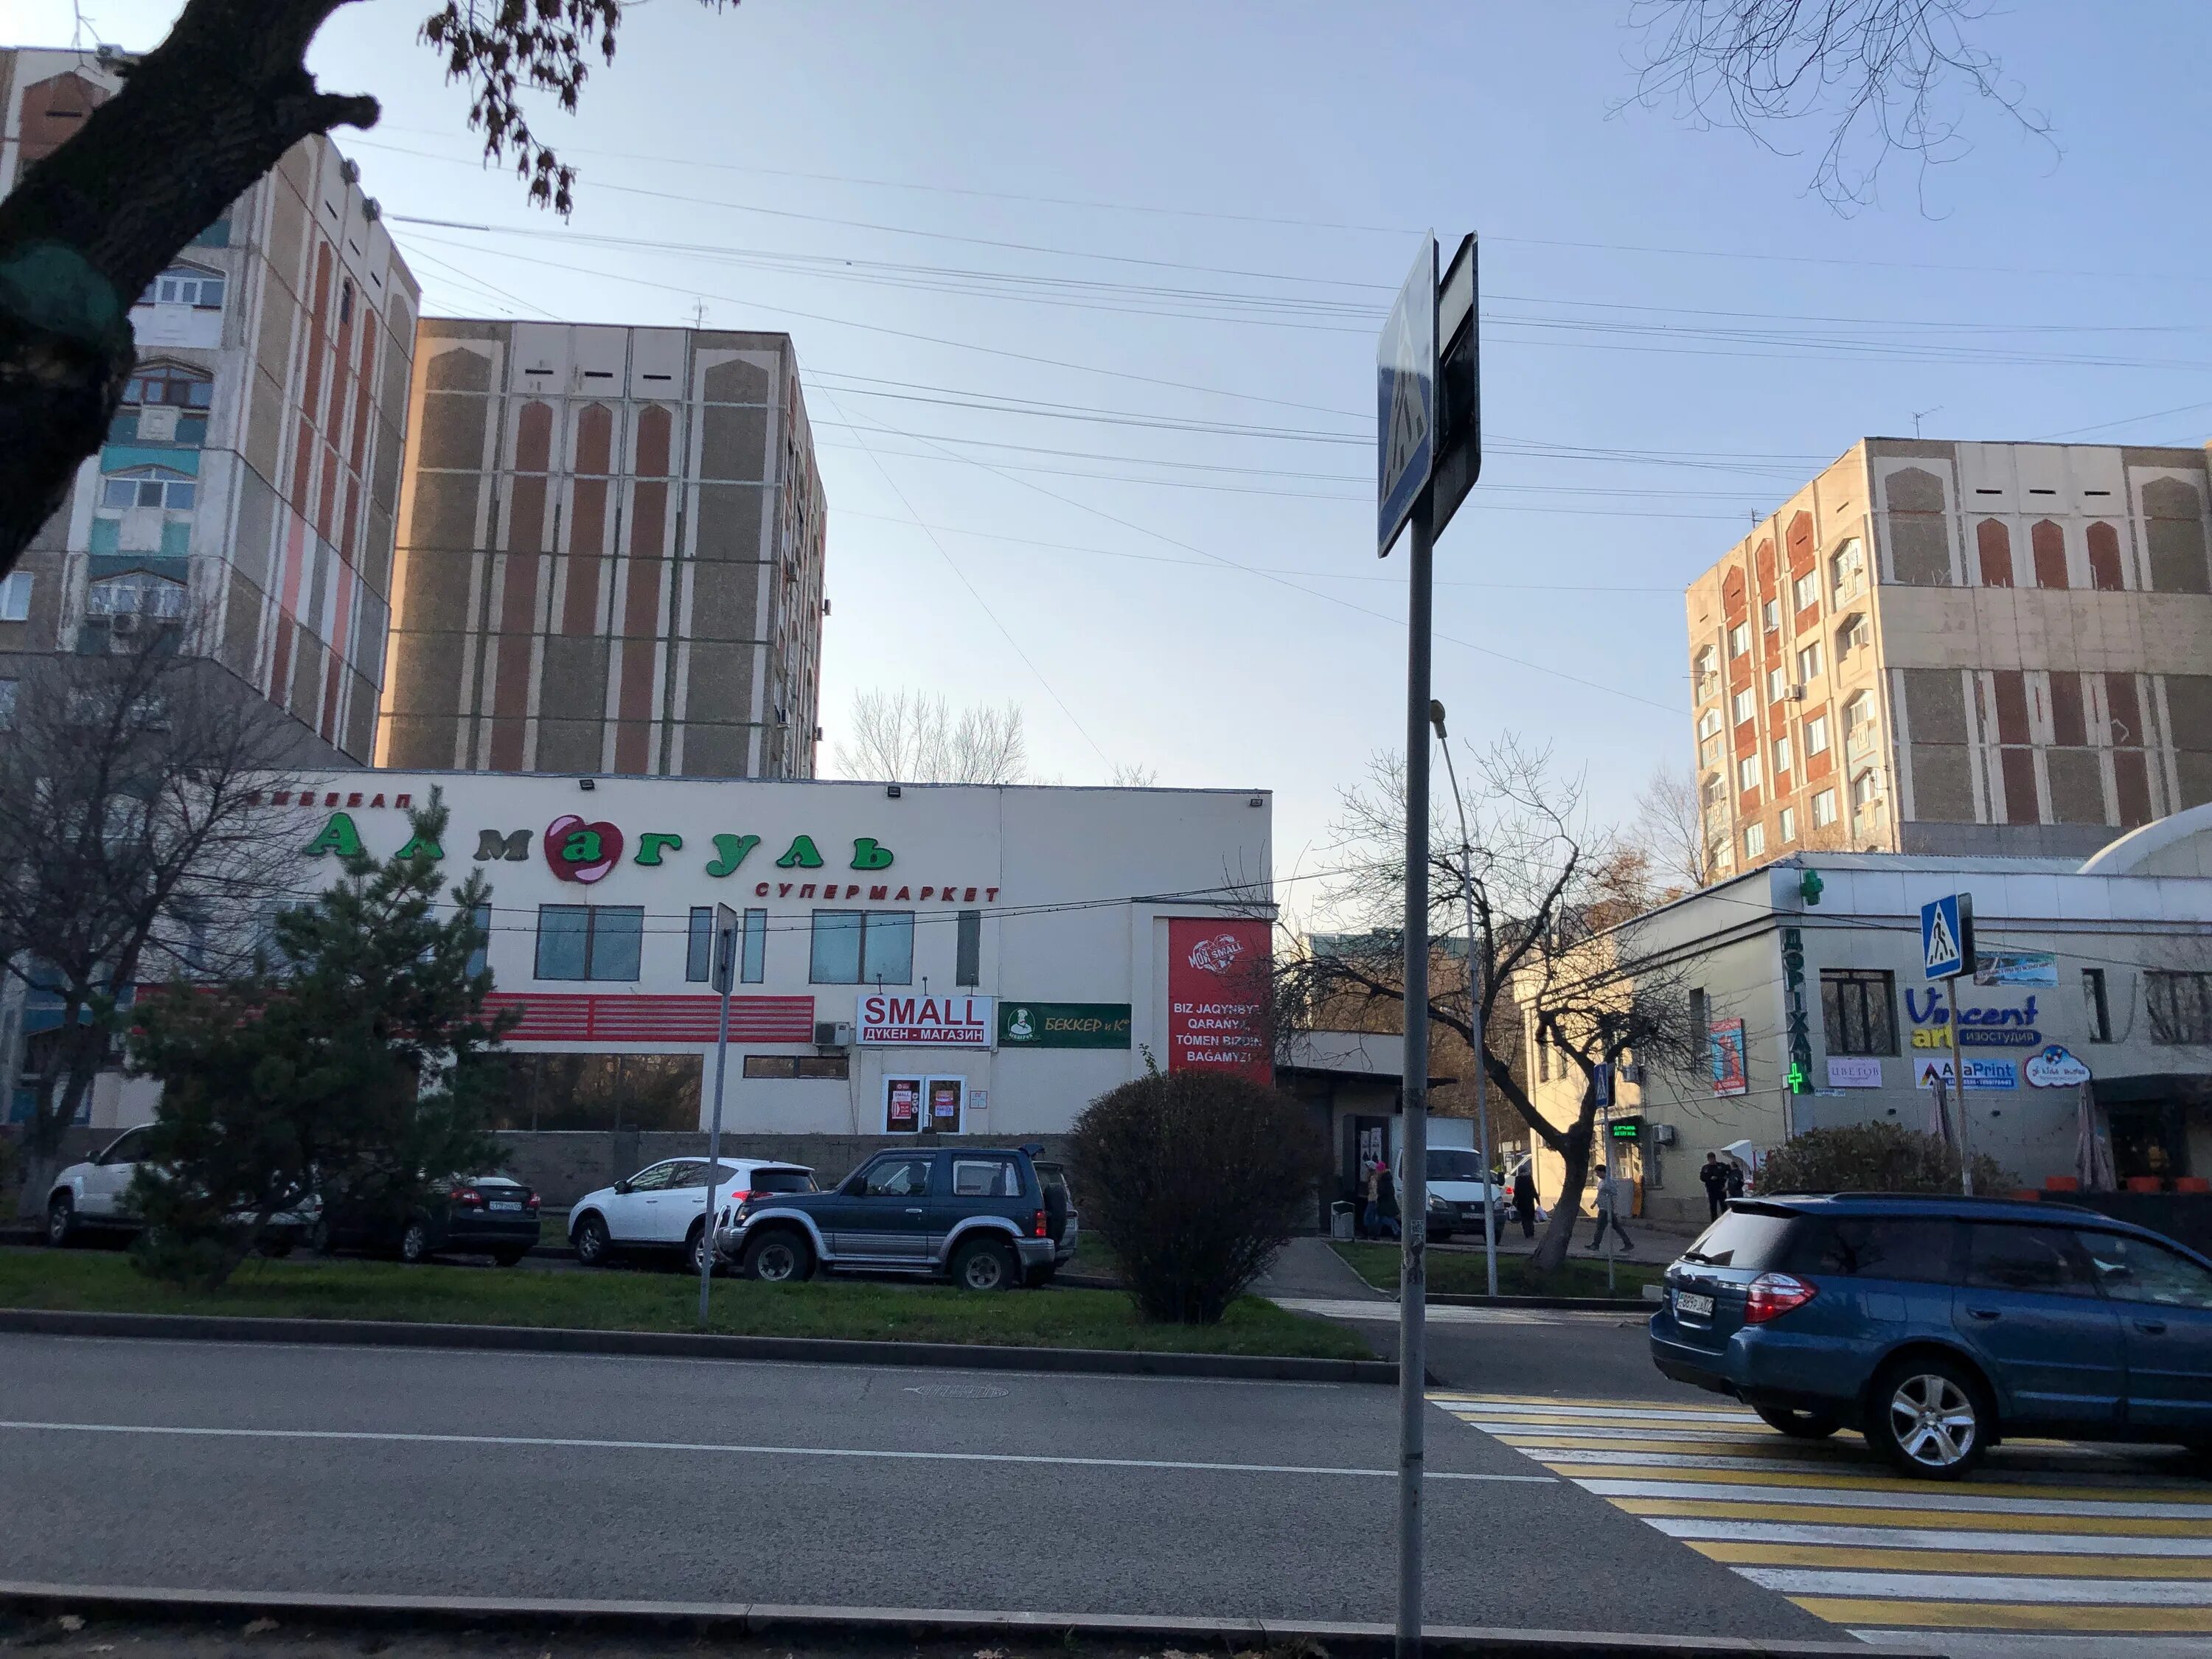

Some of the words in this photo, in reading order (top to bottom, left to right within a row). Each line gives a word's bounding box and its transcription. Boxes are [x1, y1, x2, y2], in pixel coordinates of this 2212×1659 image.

[755, 883, 999, 902] СУПЕРМАРКЕТ
[1211, 943, 1243, 959] SMALL
[864, 998, 984, 1026] SMALL
[1174, 1004, 1193, 1013] BIZ
[1045, 1018, 1102, 1032] БЕККЕР
[865, 1029, 908, 1040] ДҮКЕН
[920, 1029, 983, 1040] МАГАЗИН
[1176, 1033, 1219, 1046] TÓMEN
[1942, 1063, 2012, 1077] AaPrint
